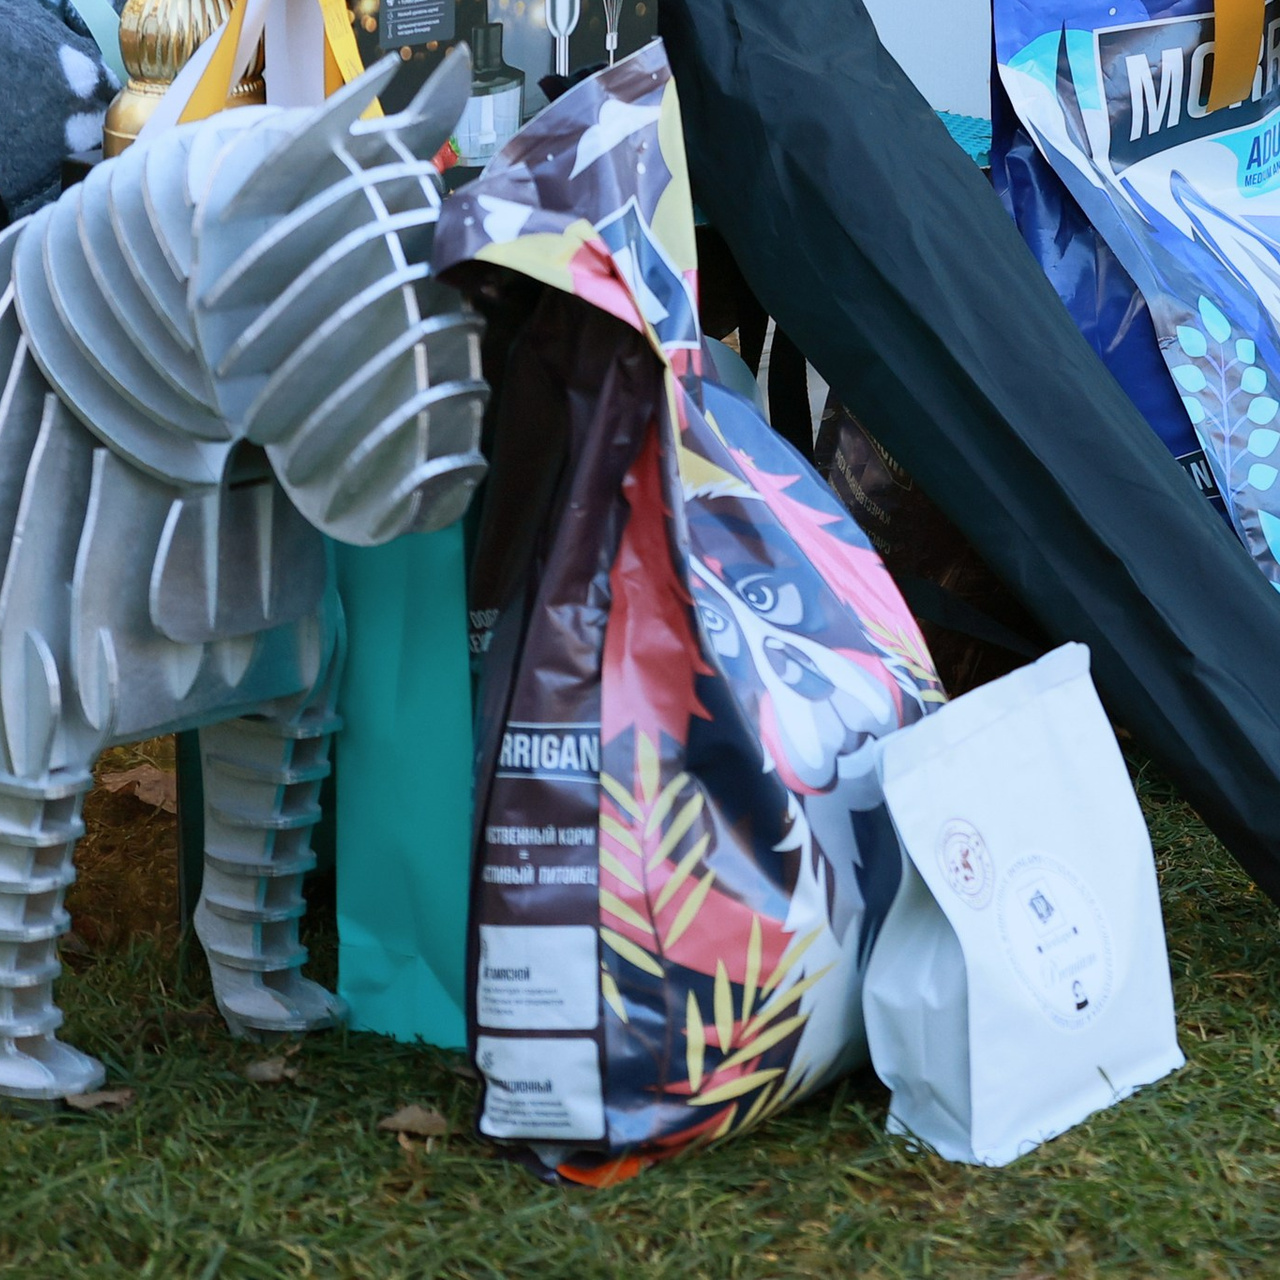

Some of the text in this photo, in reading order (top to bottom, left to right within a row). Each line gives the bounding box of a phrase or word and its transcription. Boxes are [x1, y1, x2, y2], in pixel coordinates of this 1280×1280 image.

[1244, 166, 1272, 187] MEDIUM
[558, 827, 596, 847] КОРМ
[538, 865, 598, 887] ПИТОМЕЦ
